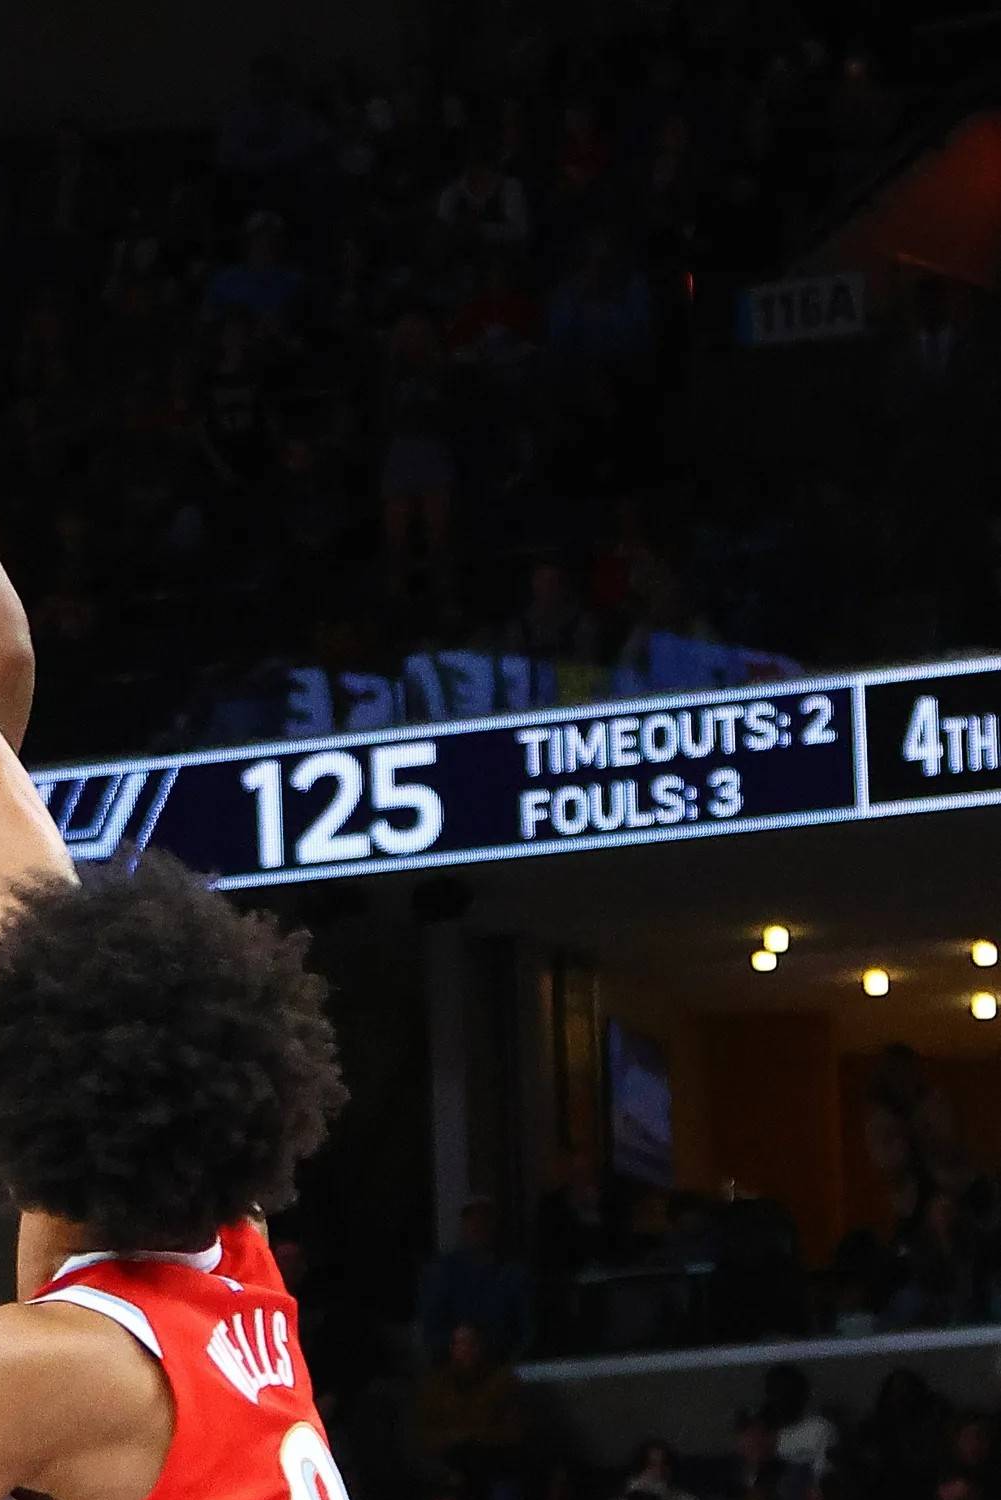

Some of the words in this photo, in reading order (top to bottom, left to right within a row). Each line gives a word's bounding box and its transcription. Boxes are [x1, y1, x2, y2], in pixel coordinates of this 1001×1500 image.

[514, 700, 792, 778] TIMEOUTS:
[800, 693, 839, 746] 2
[902, 693, 1000, 778] 4TH
[240, 740, 444, 870] 125
[518, 772, 698, 840] FOULS:
[706, 765, 744, 818] 3
